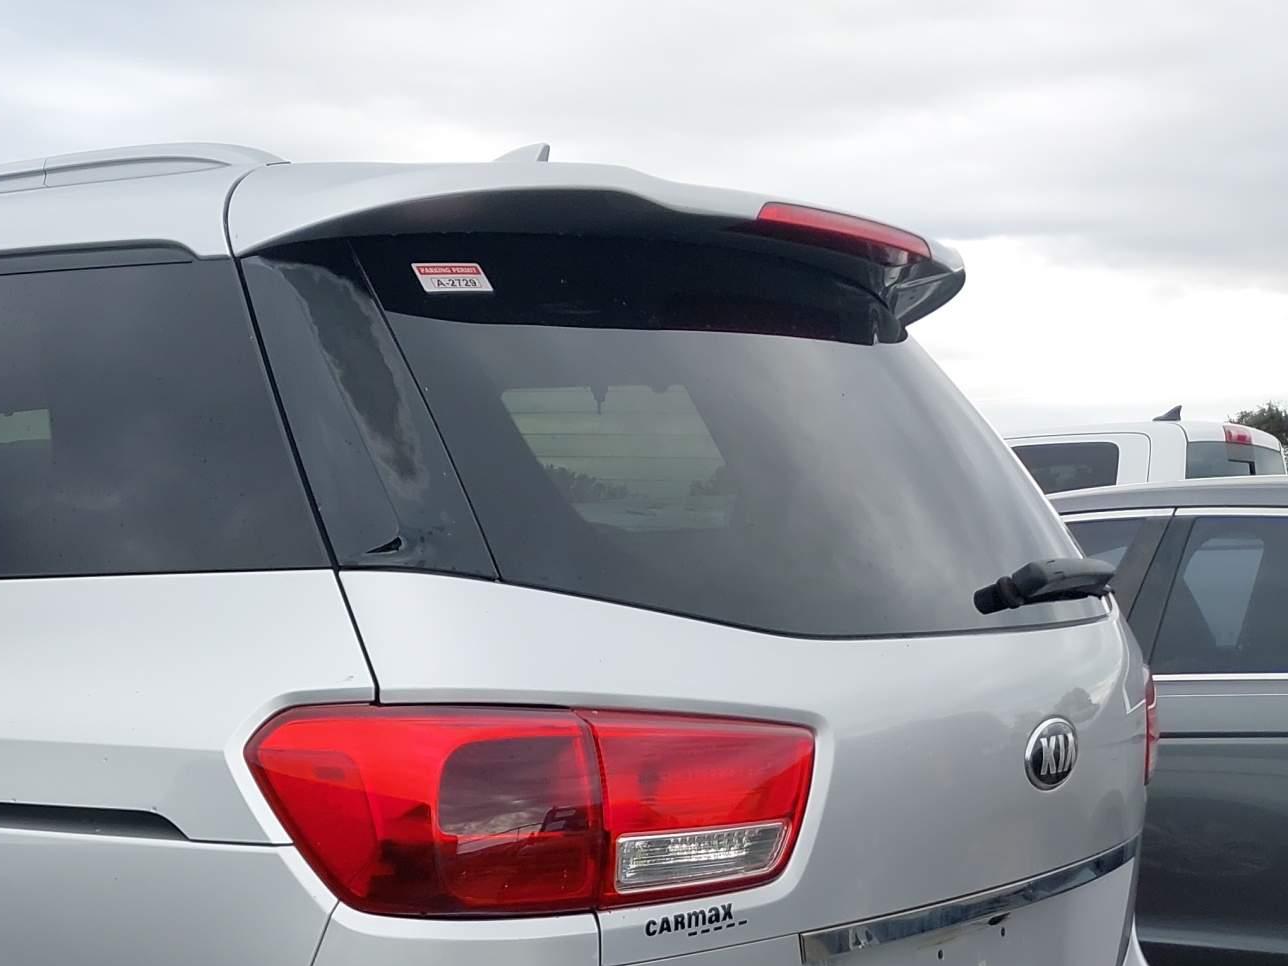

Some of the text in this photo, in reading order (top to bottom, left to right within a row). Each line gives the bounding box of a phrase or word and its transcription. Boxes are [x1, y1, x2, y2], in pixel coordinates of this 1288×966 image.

[418, 266, 478, 274] PARKING PERMIT
[436, 278, 478, 288] A-2729
